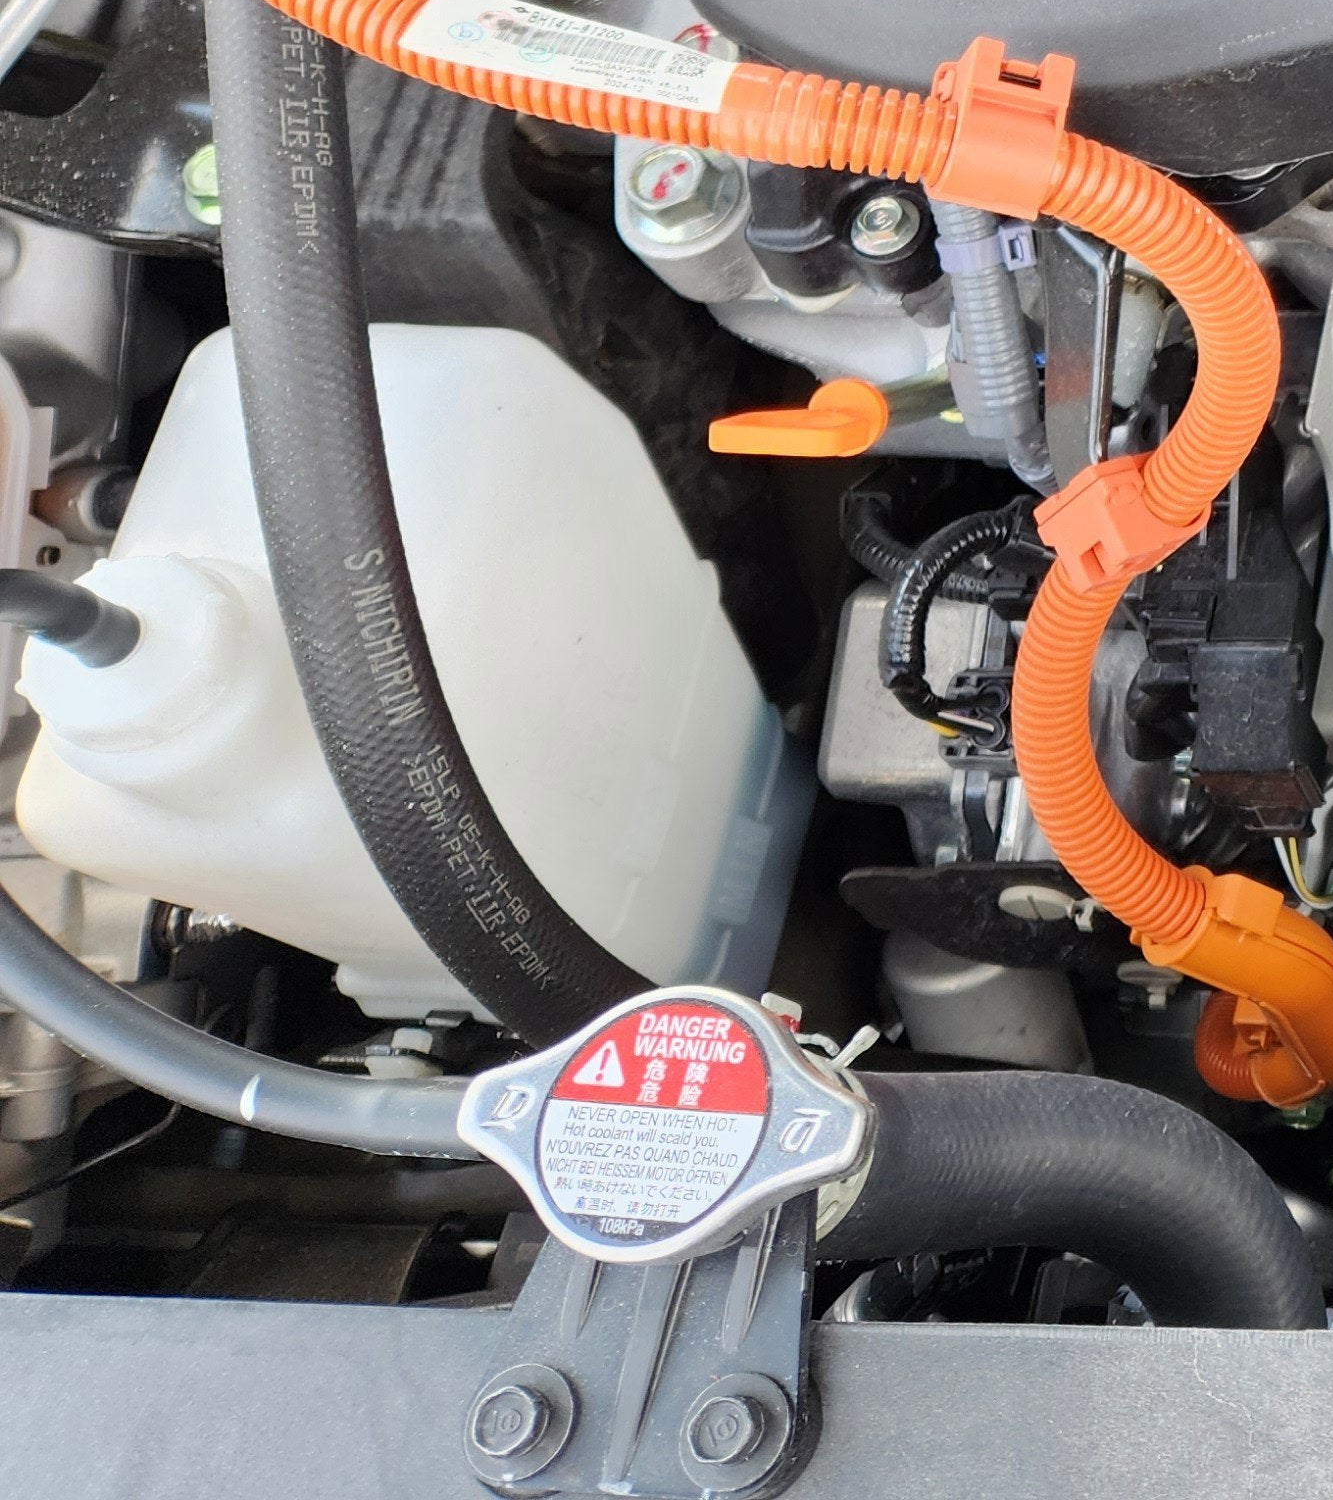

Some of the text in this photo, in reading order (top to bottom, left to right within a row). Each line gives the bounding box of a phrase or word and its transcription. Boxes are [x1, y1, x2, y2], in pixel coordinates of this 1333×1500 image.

[638, 1012, 733, 1041] DANGER
[633, 1035, 747, 1065] WARNUNG
[567, 1105, 739, 1134] NEVER OPEN WHEN HOT.
[562, 1121, 719, 1150] Hot coolant will scald you.
[546, 1139, 613, 1158] N'OUVREZ
[614, 1145, 640, 1161] PAS
[643, 1147, 689, 1165] QUAND
[545, 1158, 730, 1187] NICHT BEI HEISSEM MOTOR ÖFFNEN
[598, 1216, 646, 1237] 108kPa
